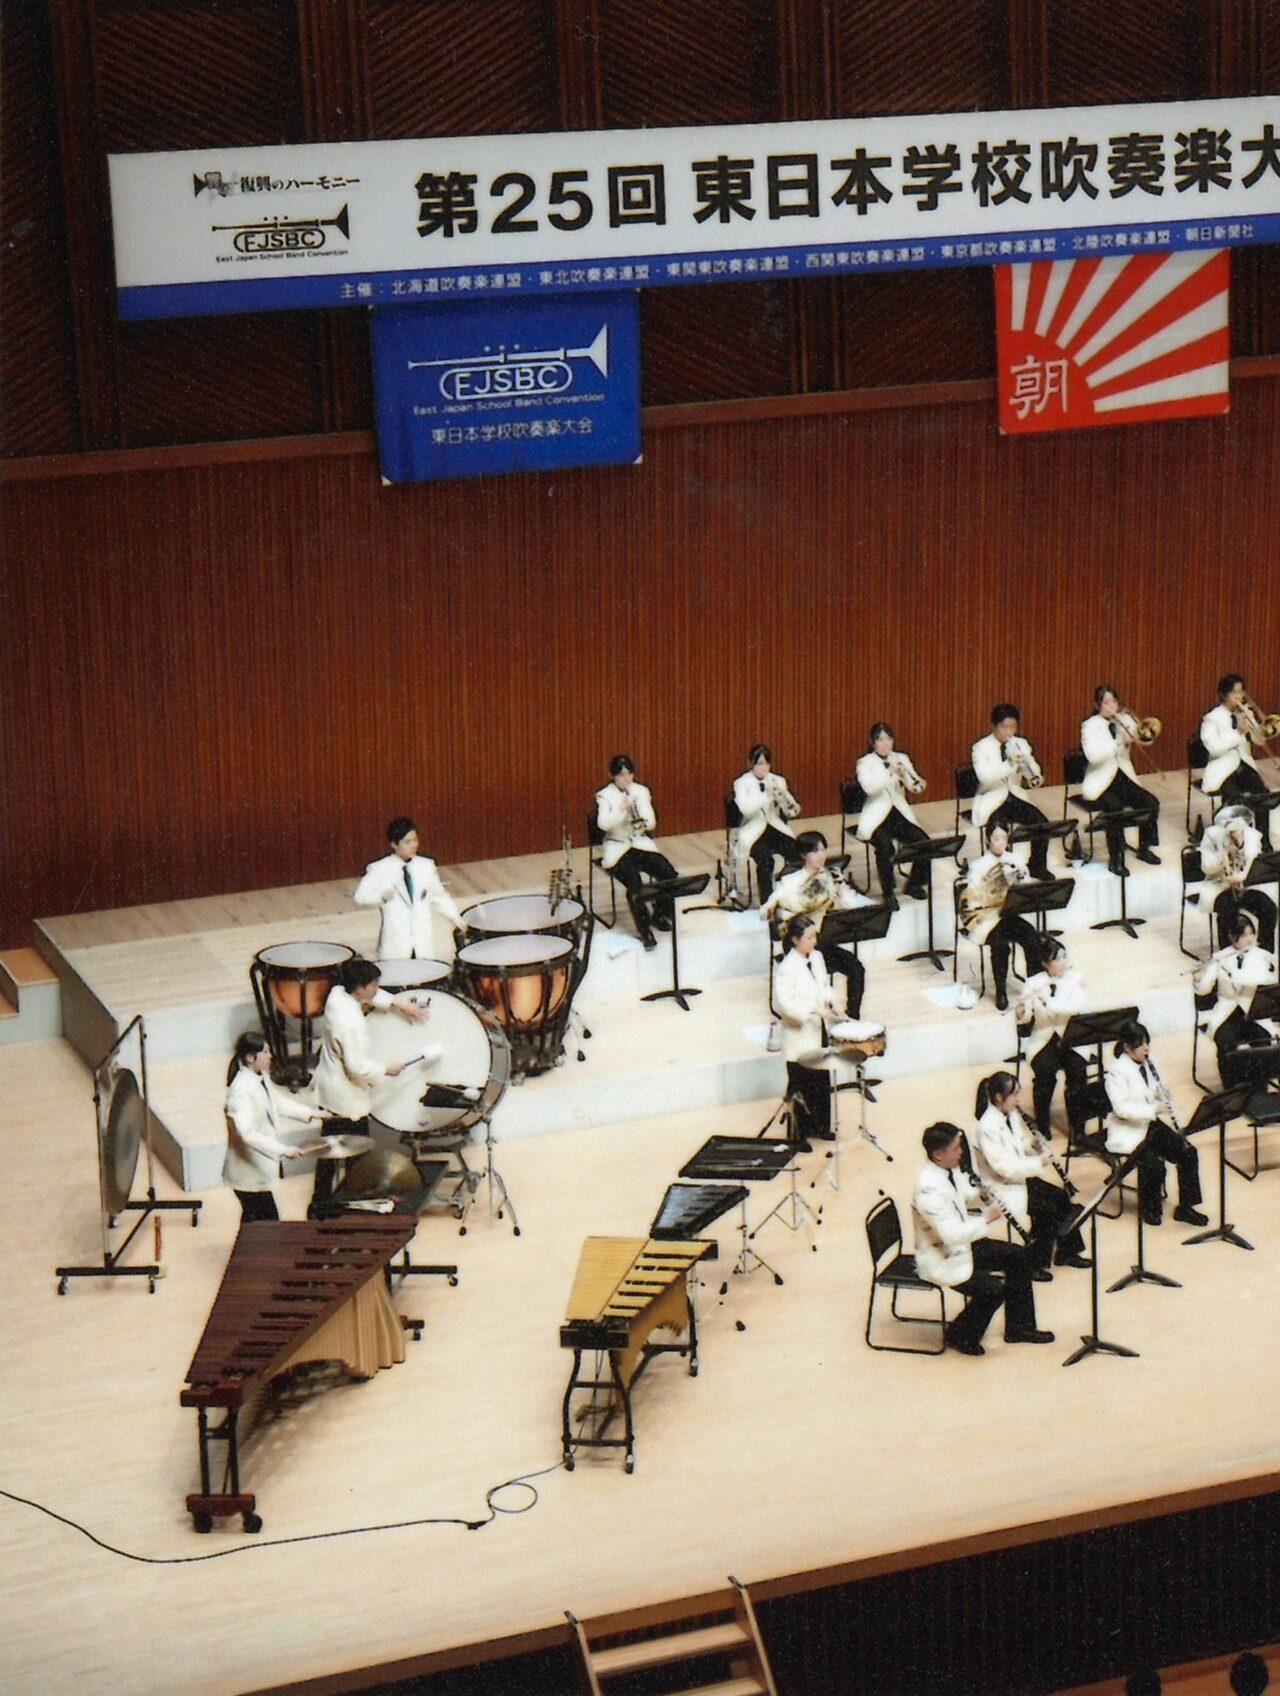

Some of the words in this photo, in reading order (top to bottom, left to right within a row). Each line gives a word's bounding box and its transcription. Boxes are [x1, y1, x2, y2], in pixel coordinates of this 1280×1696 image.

[240, 175, 361, 194] 復興のハーモニー
[414, 163, 667, 239] 第25回
[244, 230, 316, 252] EJSBC
[216, 255, 234, 263] East
[235, 254, 258, 263] Japan
[259, 251, 284, 261] School
[286, 250, 306, 260] Band
[307, 249, 349, 259] Convention
[455, 366, 559, 400] EJSBC
[1008, 354, 1068, 420] 朝
[412, 405, 438, 416] East
[441, 402, 474, 415] Japan
[476, 399, 513, 411] School
[514, 396, 543, 408] Band
[545, 393, 606, 406] Convention
[431, 416, 594, 446] 東日本学校吹奏楽大会
